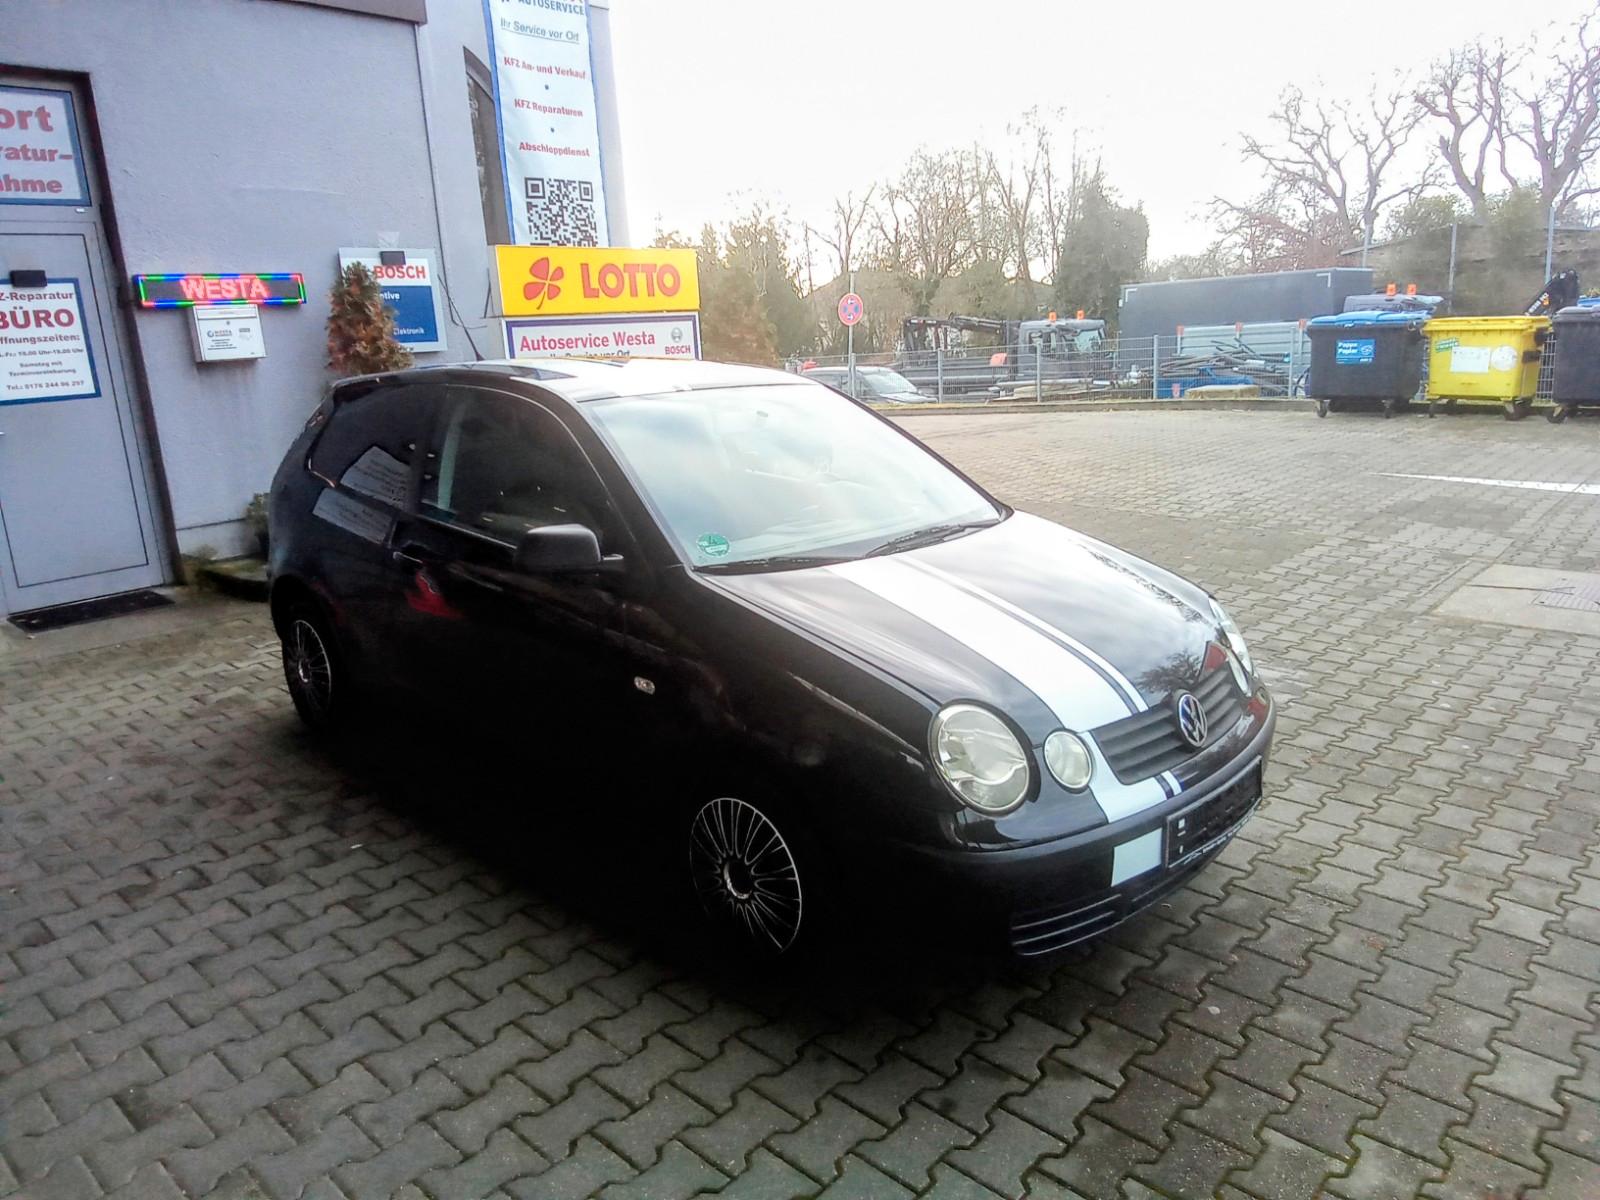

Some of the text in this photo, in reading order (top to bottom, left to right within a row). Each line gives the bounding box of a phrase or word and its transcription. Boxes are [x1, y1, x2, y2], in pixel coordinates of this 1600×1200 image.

[500, 17, 579, 42] Ihr Service vor Ort
[503, 56, 520, 67] KFZ
[536, 65, 552, 74] und
[555, 66, 586, 79] Verkauf
[514, 98, 583, 117] KFZ Reparaturen
[519, 141, 590, 157] Abschleppdienst
[0, 173, 62, 193] hme
[373, 265, 426, 279] BOSCH
[580, 262, 681, 299] LOTTO
[180, 278, 268, 300] WESTA
[0, 306, 75, 330] BÜRO
[392, 326, 425, 336] Elektronik
[520, 330, 655, 351] Autoservice Westa
[664, 344, 691, 355] BOSCH
